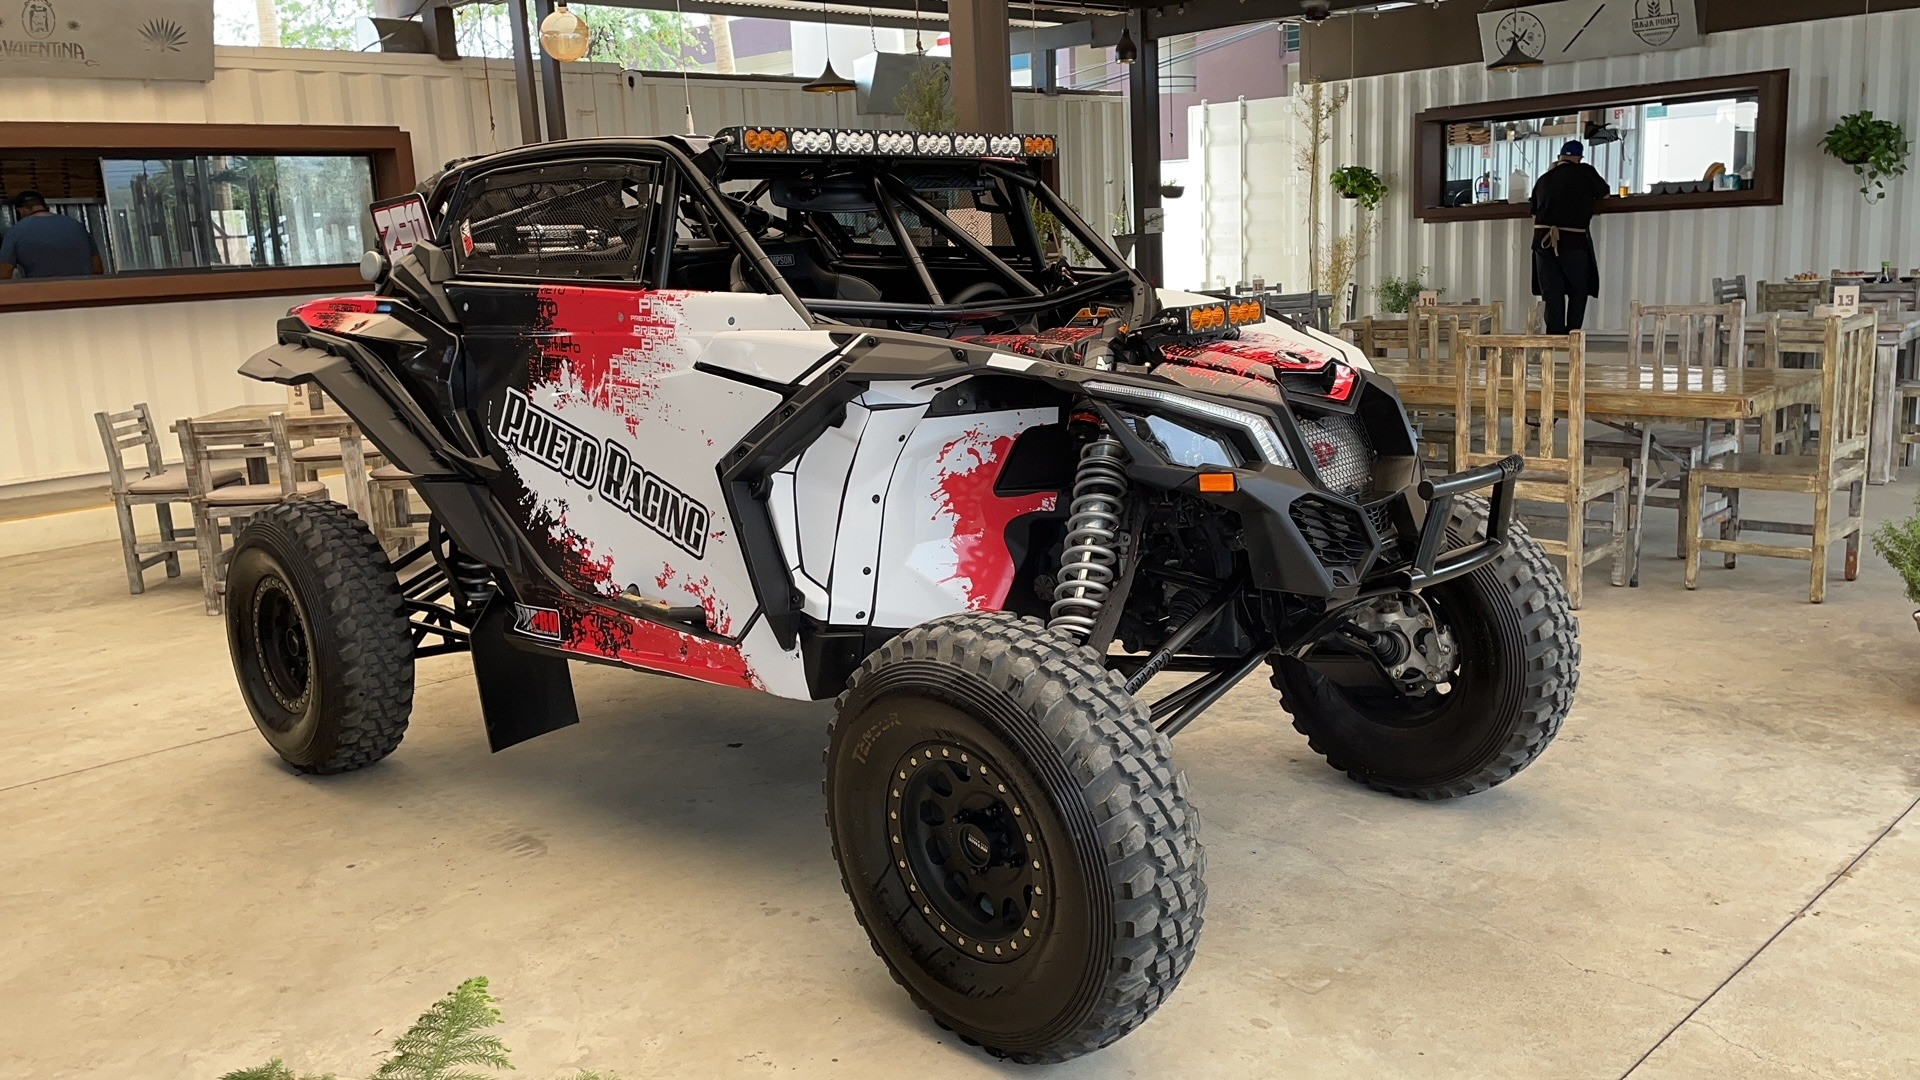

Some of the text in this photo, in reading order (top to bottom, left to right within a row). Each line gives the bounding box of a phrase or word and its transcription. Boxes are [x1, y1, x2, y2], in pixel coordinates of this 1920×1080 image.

[1633, 16, 1677, 28] BAJA POINT
[1422, 297, 1436, 307] 14
[1837, 294, 1855, 307] 13
[500, 389, 708, 556] PRIETO RACING
